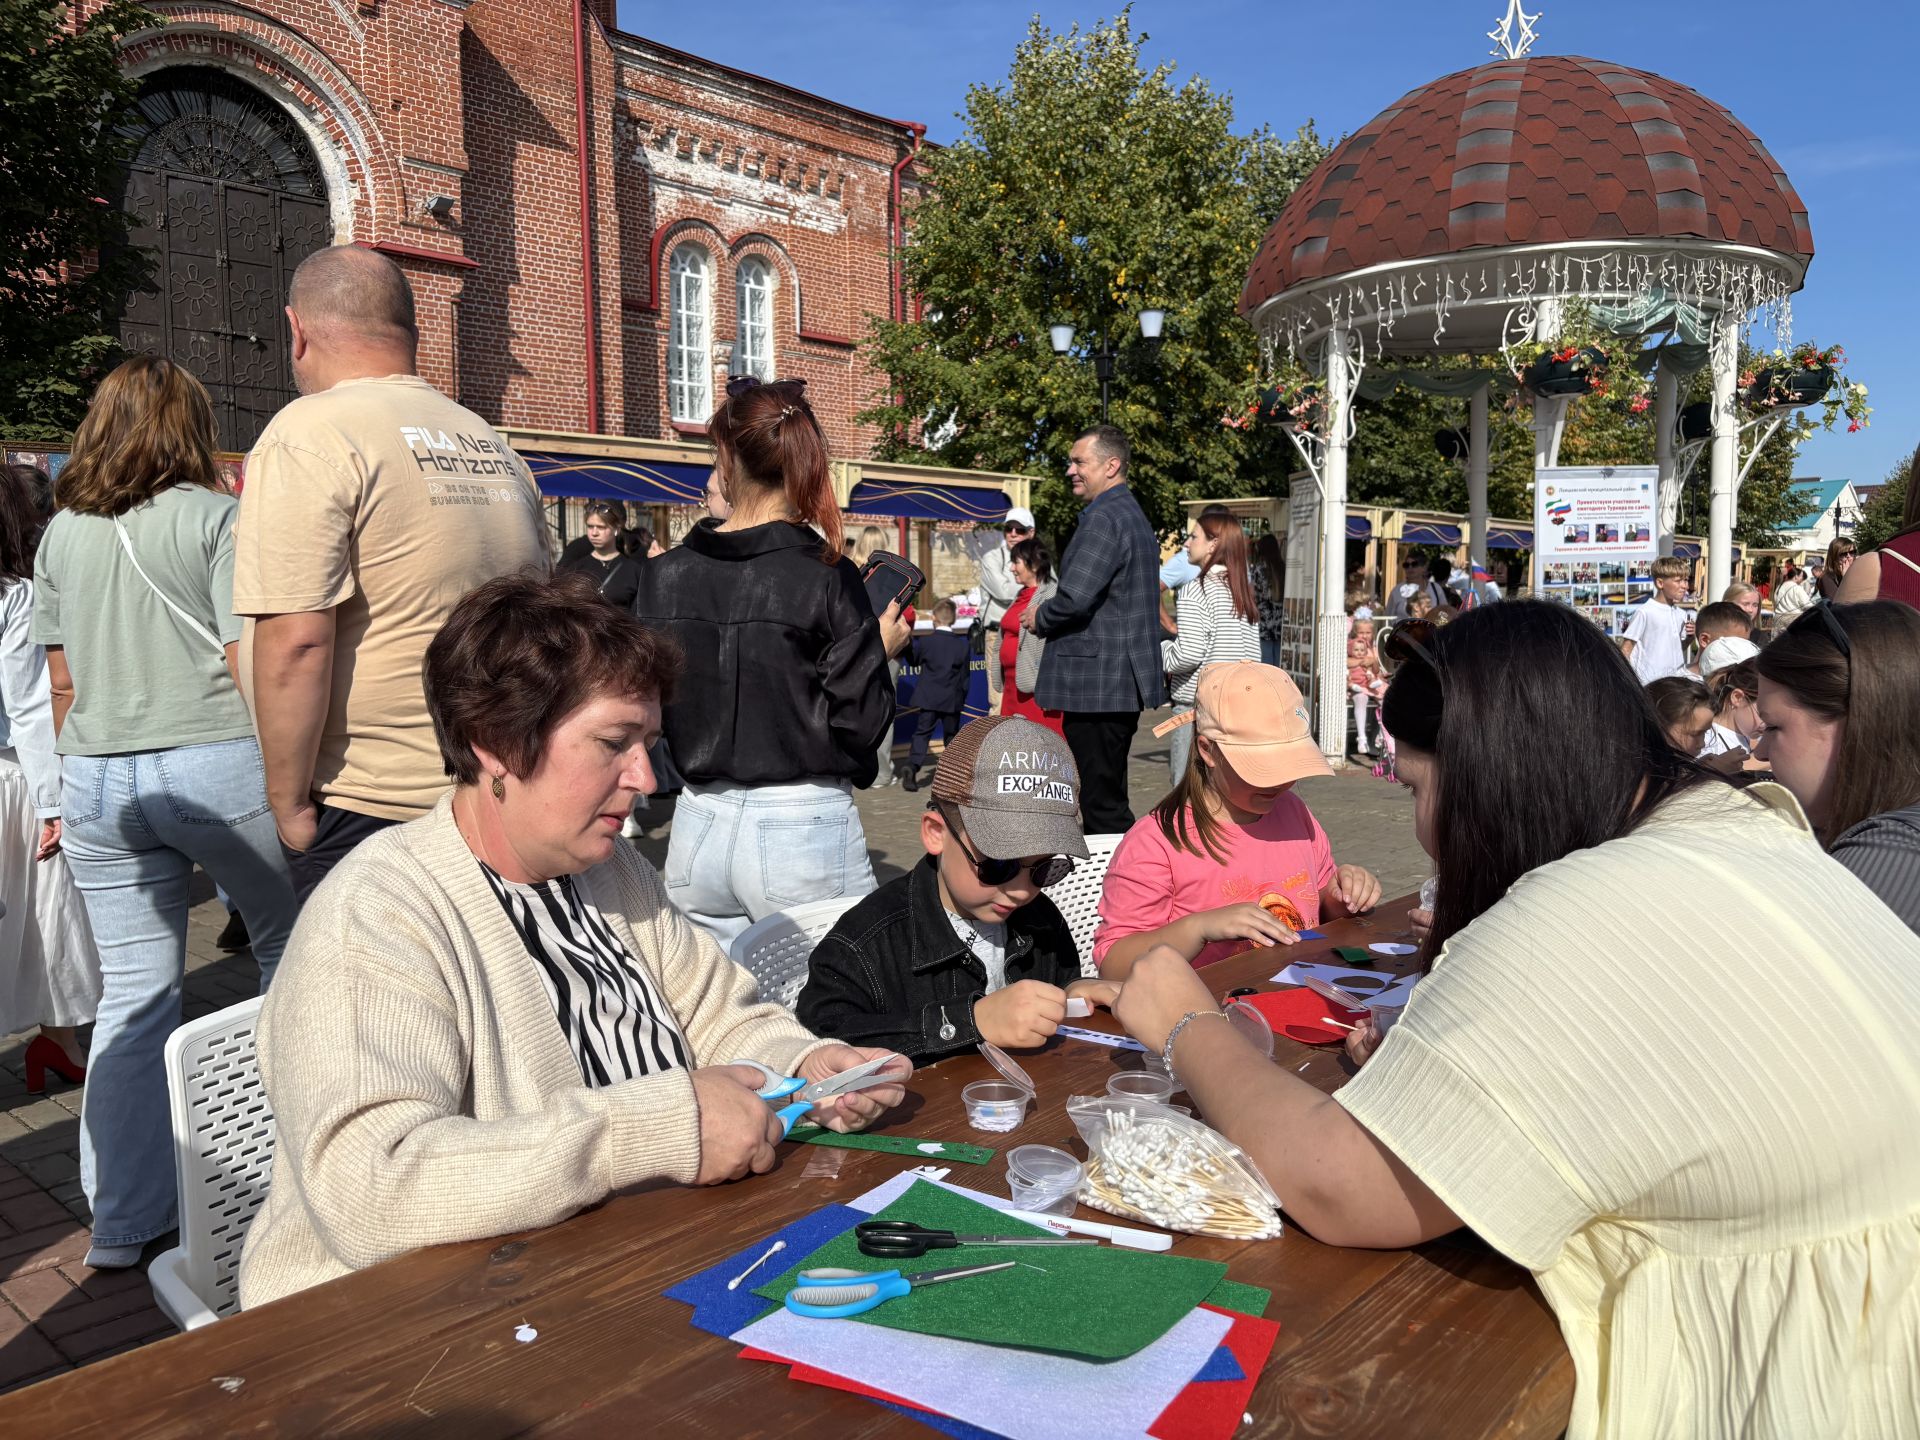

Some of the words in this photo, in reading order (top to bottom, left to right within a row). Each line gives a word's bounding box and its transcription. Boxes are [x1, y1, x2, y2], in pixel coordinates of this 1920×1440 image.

[400, 426, 456, 451] FILA
[412, 449, 516, 476] Horizons
[430, 496, 471, 506] SUMMER
[472, 497, 490, 506] SIDE
[1002, 776, 1072, 802] EXCHANGE
